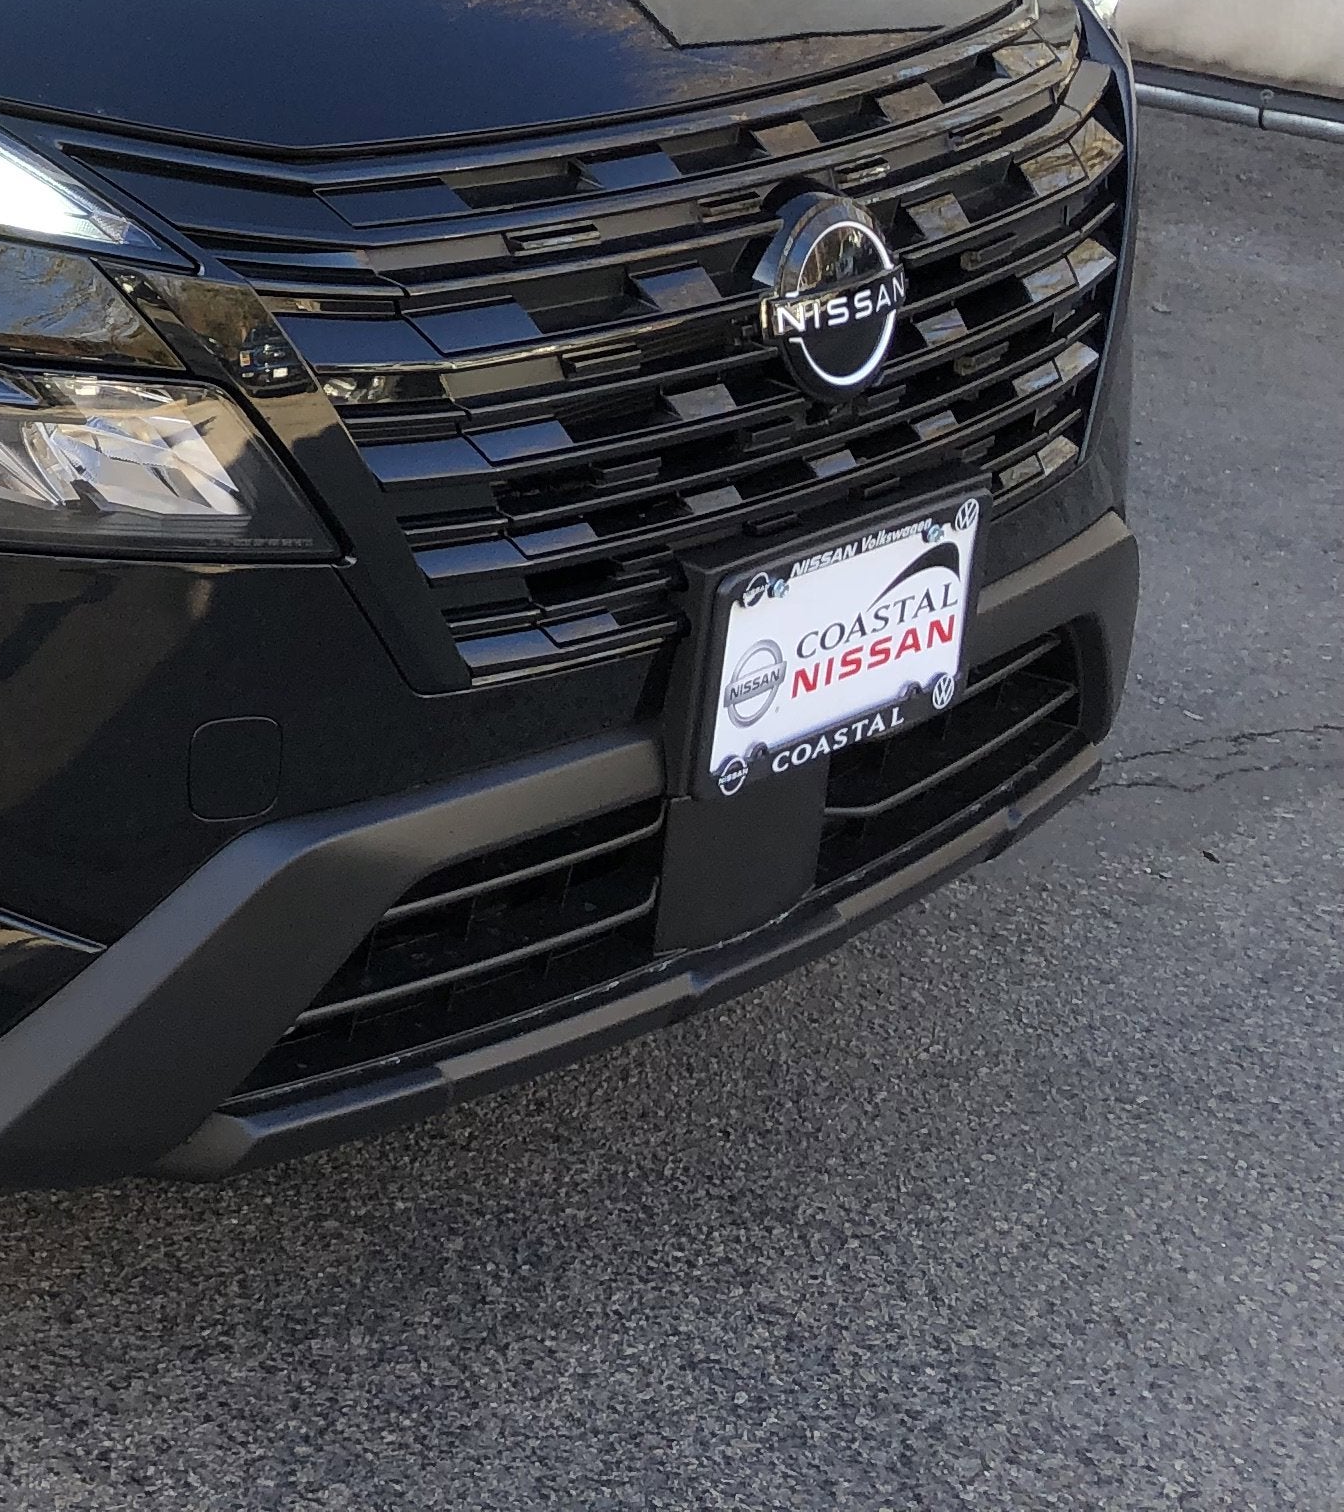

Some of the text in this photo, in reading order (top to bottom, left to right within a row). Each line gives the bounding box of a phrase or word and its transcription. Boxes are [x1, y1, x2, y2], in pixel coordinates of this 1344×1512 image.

[775, 271, 906, 334] NISSAN
[790, 541, 859, 578] NISSAN
[795, 582, 959, 660] COASTAL
[729, 669, 781, 701] NISSAN
[791, 614, 955, 699] NISSAN
[771, 706, 905, 773] COASTAL
